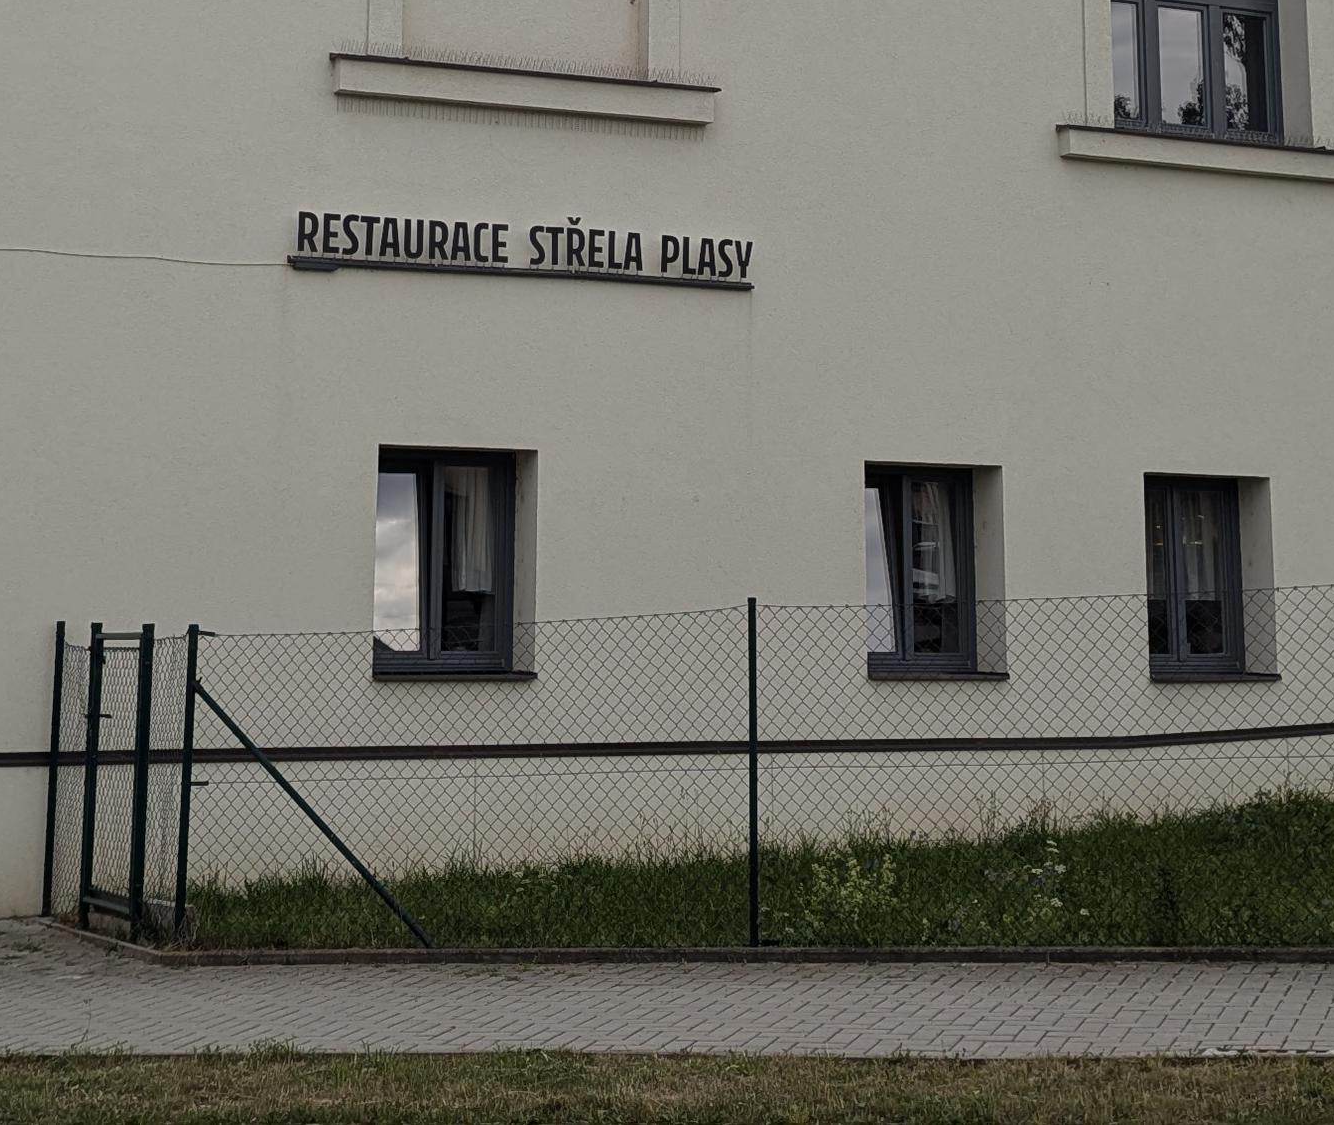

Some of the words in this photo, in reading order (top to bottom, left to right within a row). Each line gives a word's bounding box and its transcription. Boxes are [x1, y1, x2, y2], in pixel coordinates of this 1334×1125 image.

[297, 211, 509, 264] RESTAURACE
[529, 217, 643, 271] STŘELA
[661, 234, 754, 279] PLASY
